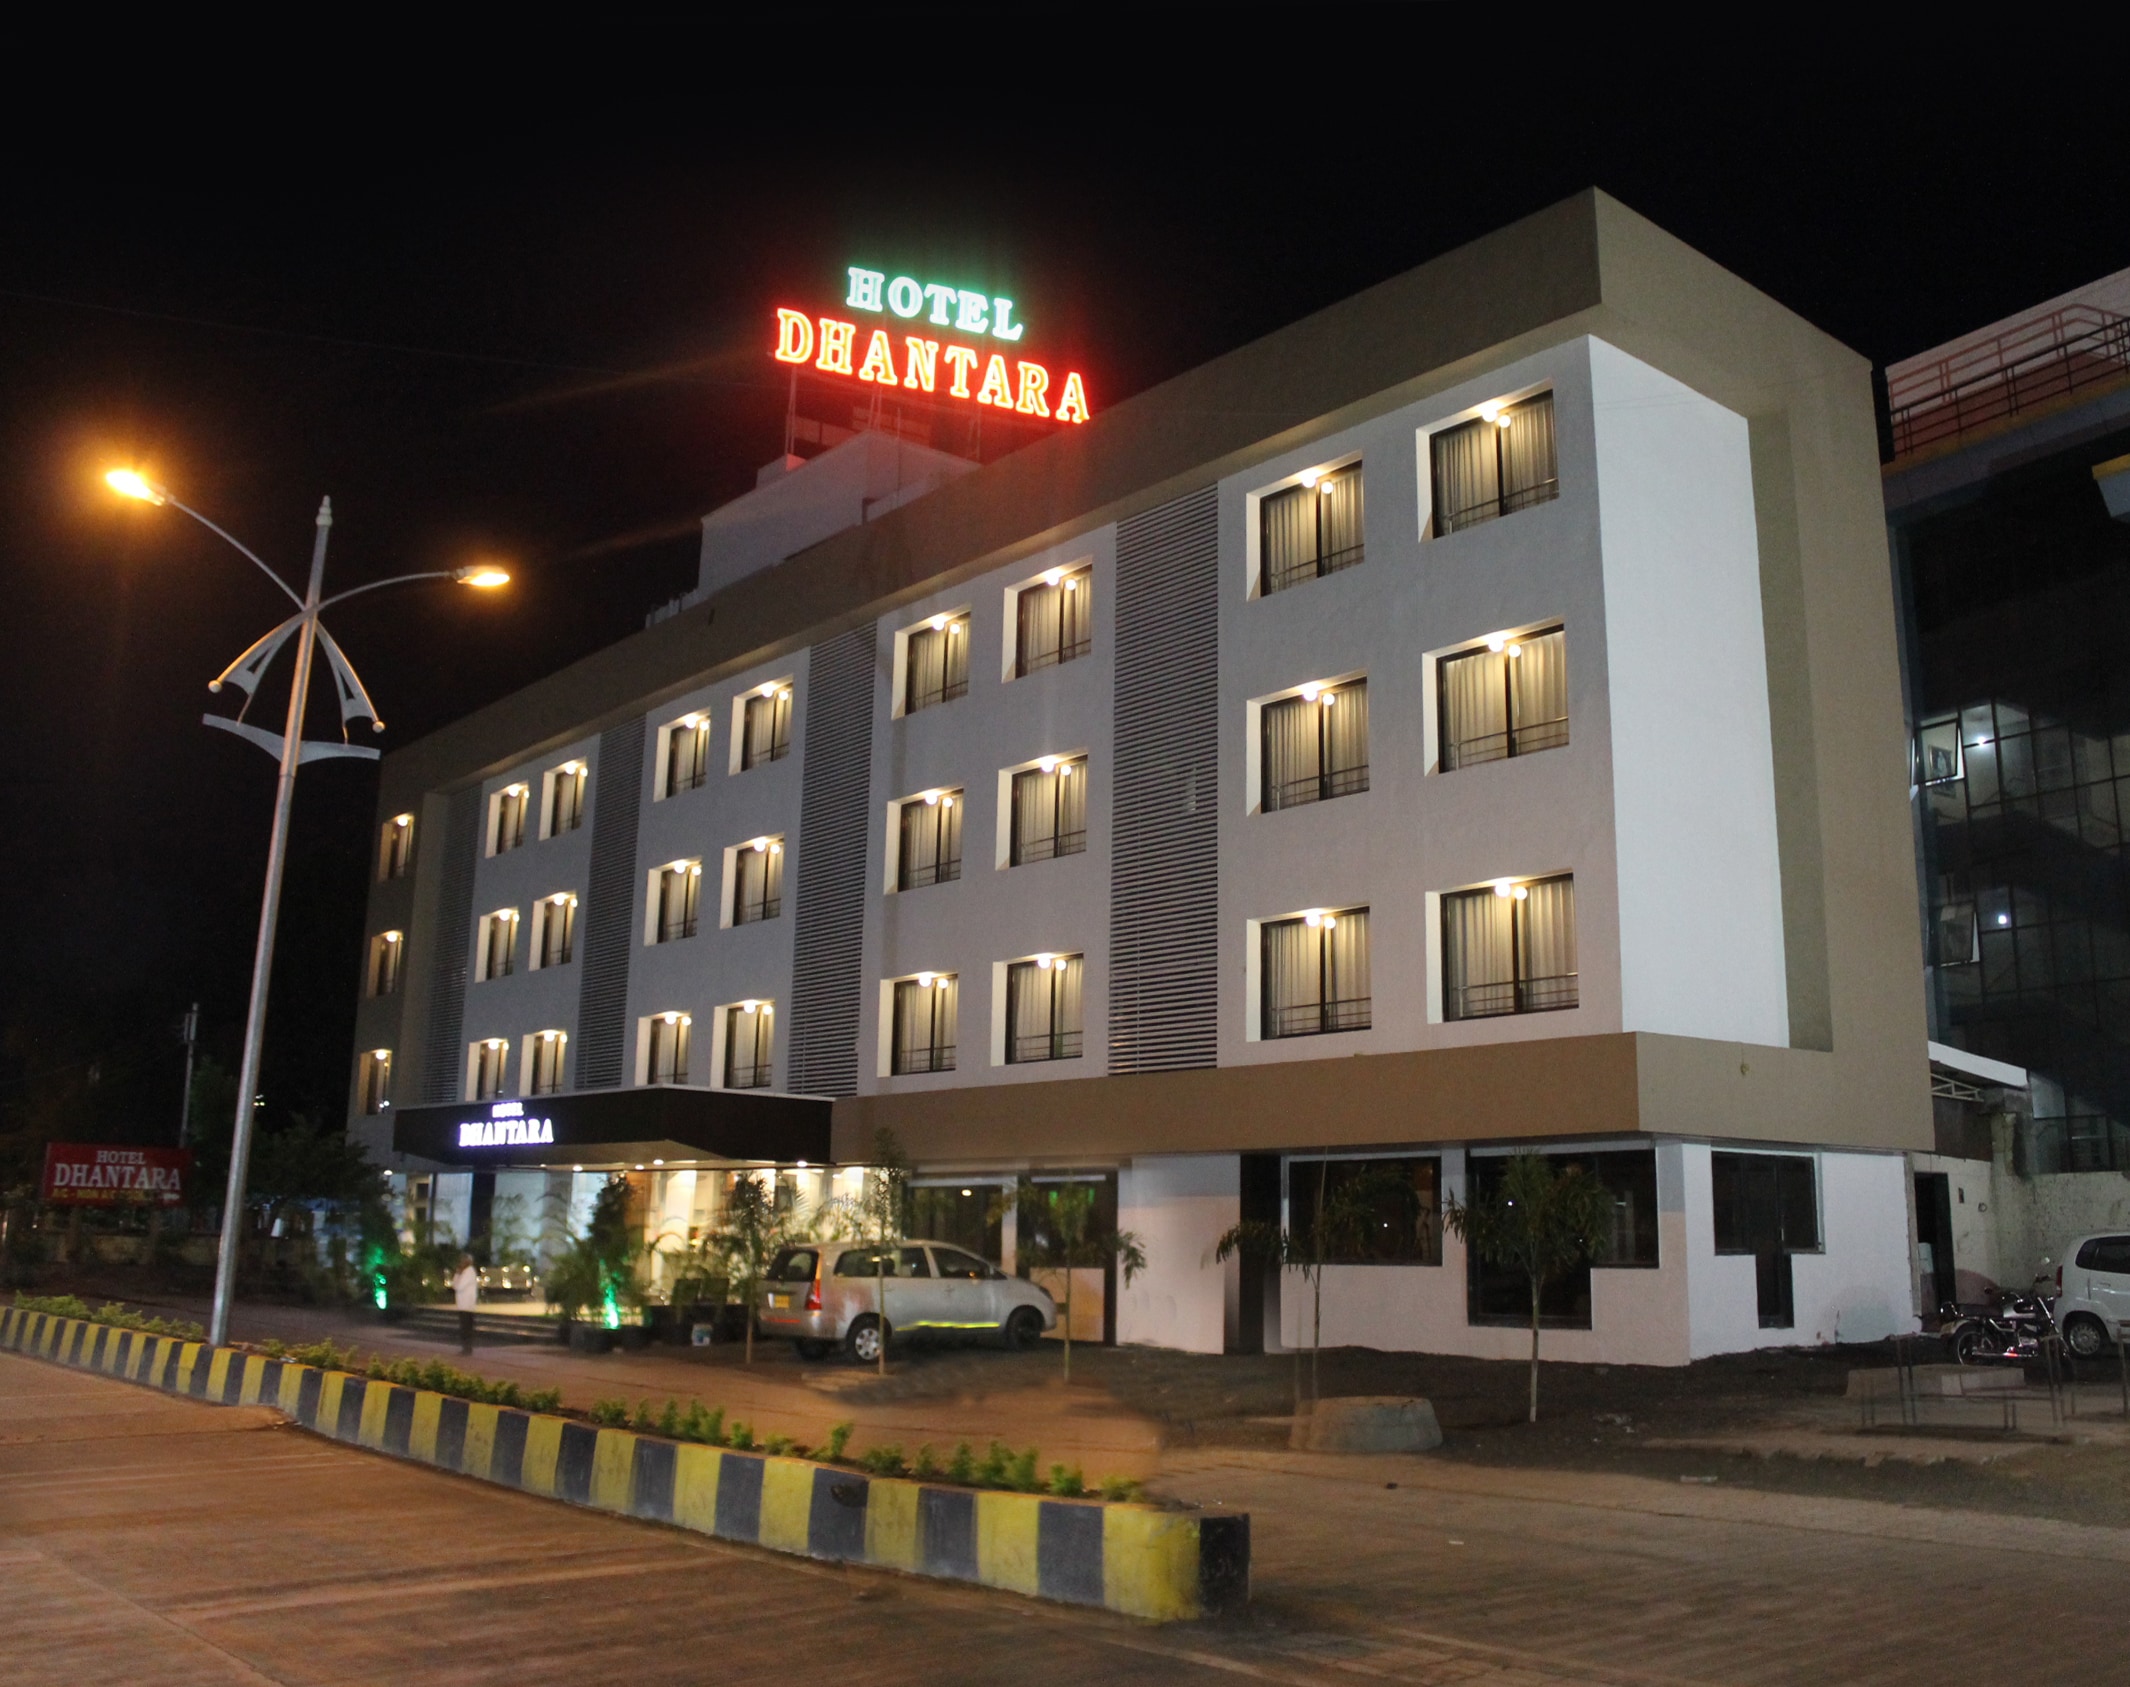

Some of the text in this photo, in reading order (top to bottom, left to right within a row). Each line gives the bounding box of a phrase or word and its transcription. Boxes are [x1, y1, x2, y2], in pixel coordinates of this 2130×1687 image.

[847, 266, 1023, 341] HOTEL
[775, 308, 1090, 424] DHANTARA
[459, 1118, 554, 1147] DHANTARA
[96, 1150, 146, 1165] HOTEL
[54, 1163, 181, 1190] DHANTARA
